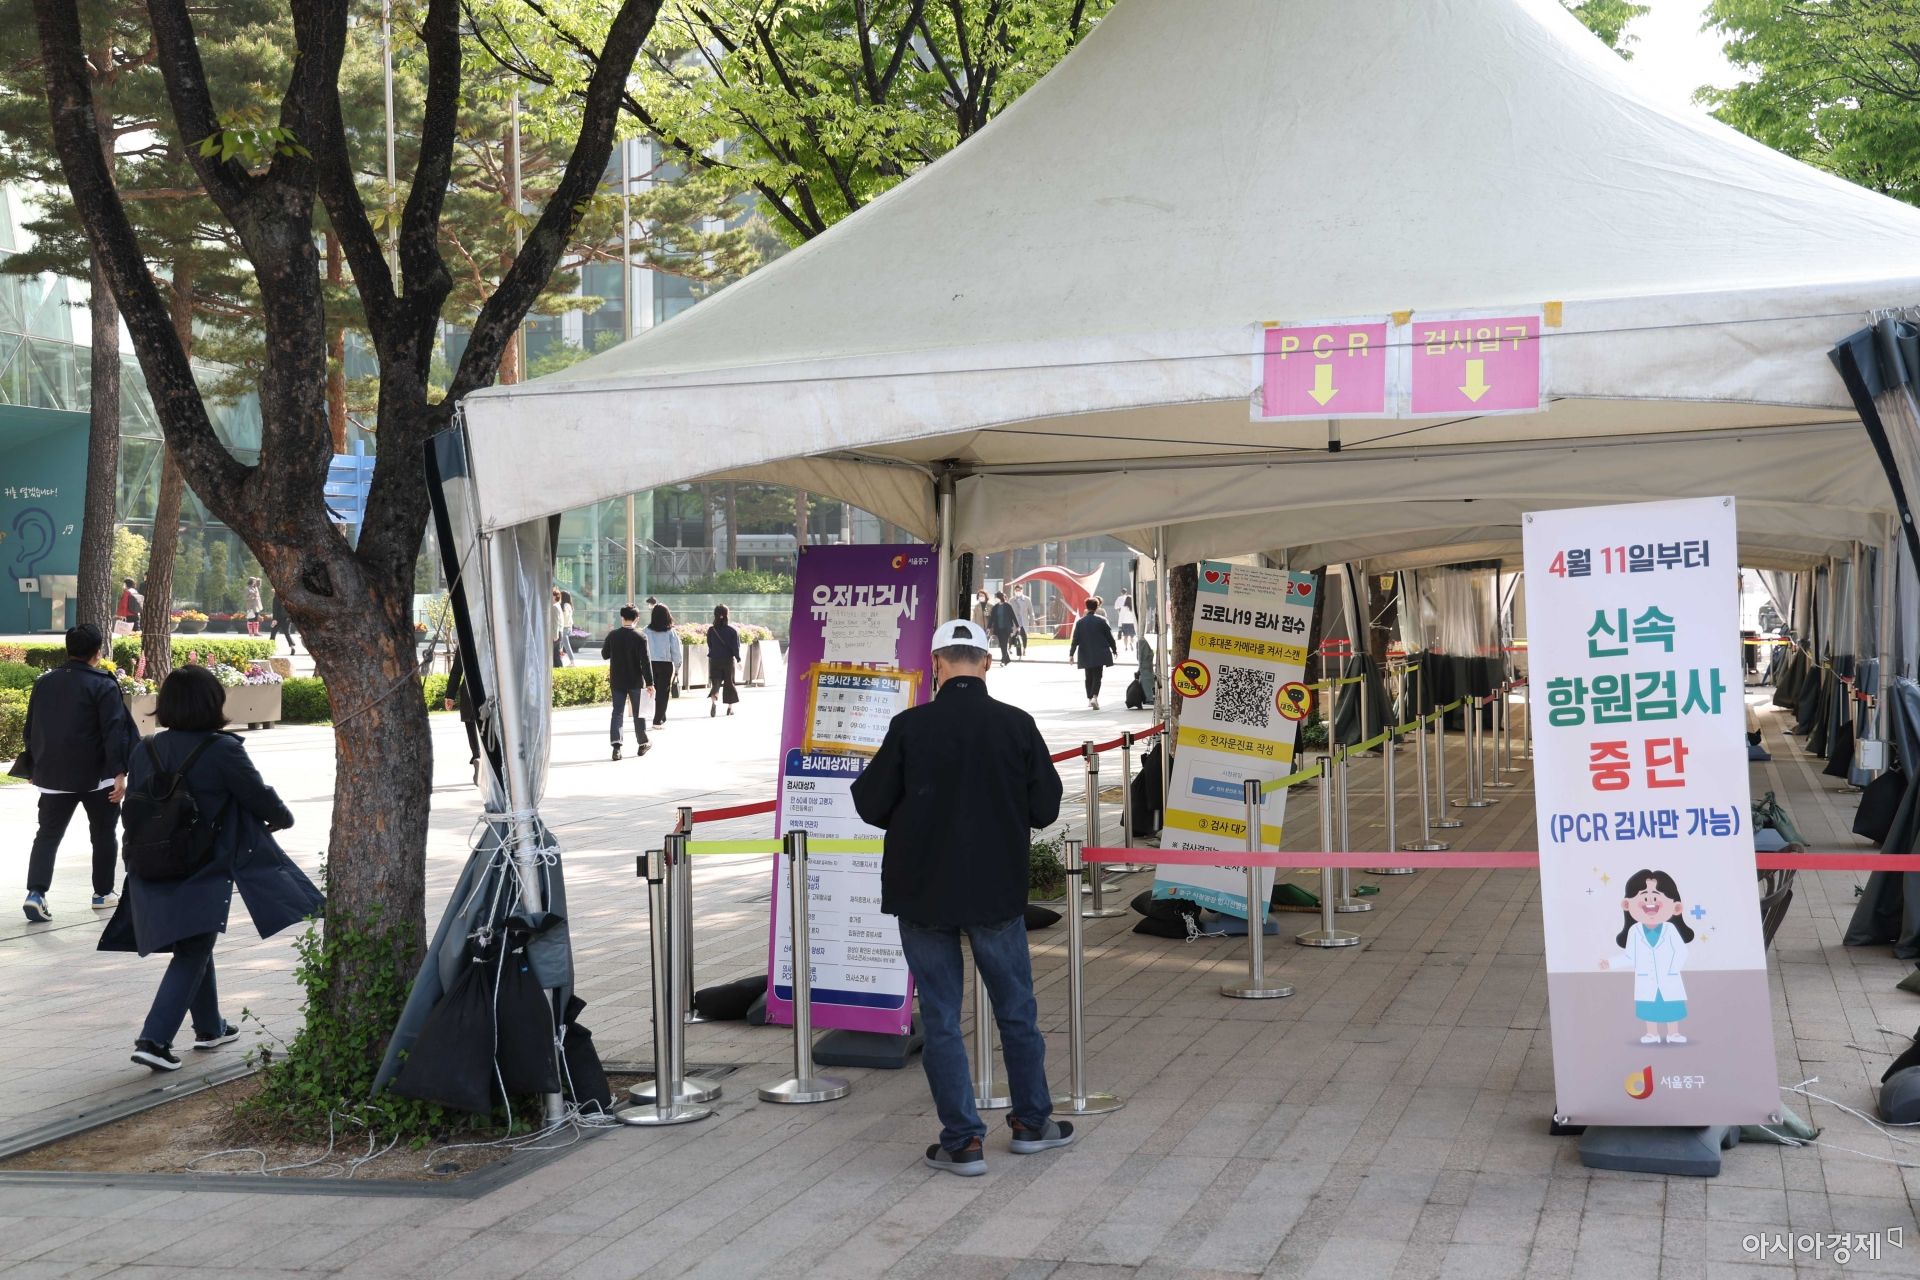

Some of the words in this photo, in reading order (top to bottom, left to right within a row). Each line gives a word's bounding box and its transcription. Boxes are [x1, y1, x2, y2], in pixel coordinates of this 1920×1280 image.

[908, 557, 929, 566] 서울중구
[1548, 548, 1591, 578] 4월
[1599, 539, 1710, 575] 11일부터
[1200, 604, 1252, 625] 코로나19
[1254, 611, 1280, 631] 검사
[1281, 615, 1306, 635] 접수
[1586, 605, 1676, 658] 신속
[1208, 636, 1233, 650] 휴대폰
[1233, 640, 1265, 655] 카메라를
[1267, 644, 1284, 658] 켜서
[1284, 648, 1301, 661] 스캔
[818, 674, 851, 686] 운영시간
[852, 676, 861, 686] 및
[881, 679, 900, 690] 안내
[1546, 668, 1727, 727] 항원검사
[1210, 736, 1255, 751] 전자문진표
[1256, 742, 1274, 756] 작성
[802, 756, 860, 772] 검사대상자별
[786, 780, 816, 791] 검사대상자
[1211, 820, 1229, 833] 검사
[1551, 812, 1609, 844] (PCR
[1614, 808, 1680, 841] 검사만
[1685, 805, 1741, 838] 가능)
[1660, 1074, 1706, 1090] 서울중구
